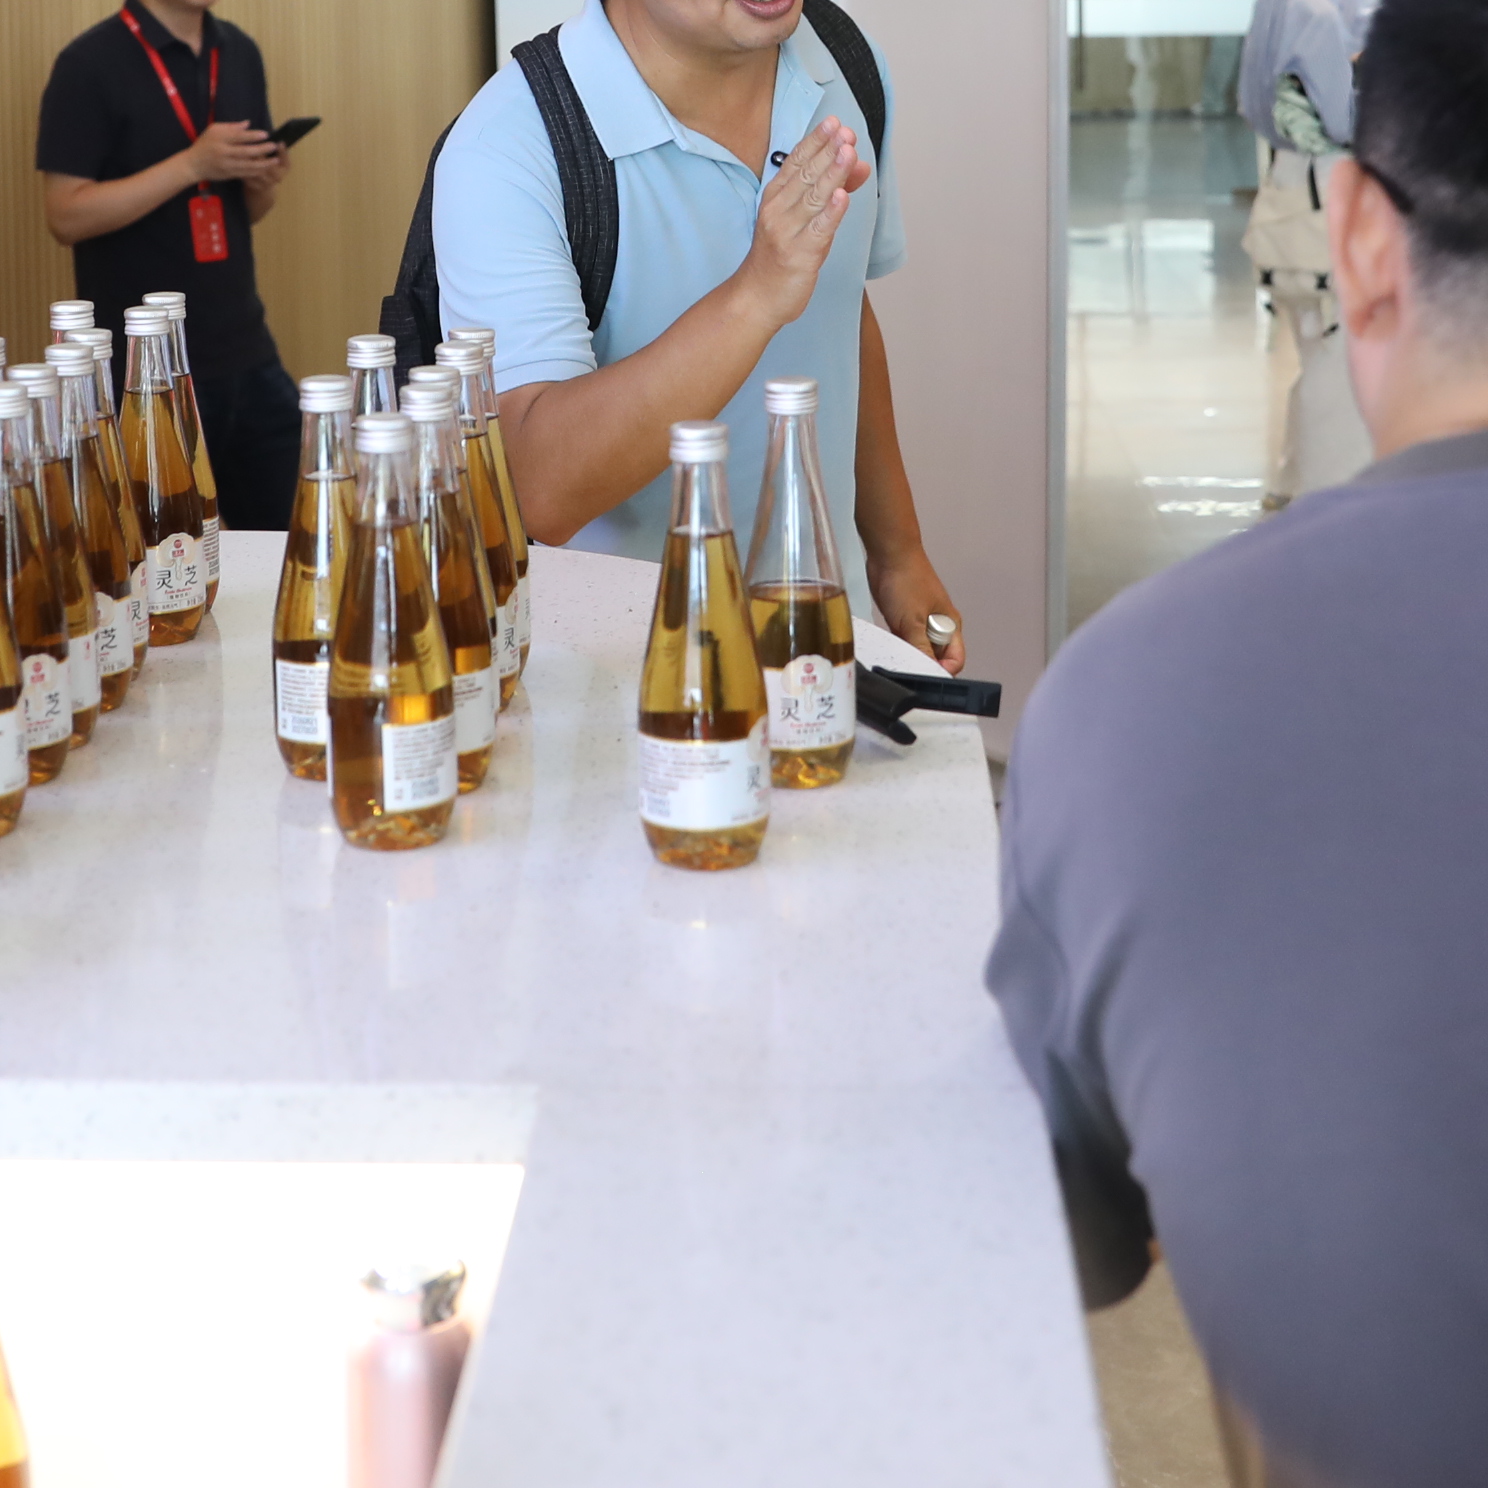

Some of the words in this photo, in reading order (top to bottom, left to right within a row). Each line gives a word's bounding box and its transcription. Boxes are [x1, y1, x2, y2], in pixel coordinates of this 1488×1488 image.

[155, 564, 198, 591] 灵芝
[95, 627, 118, 651] 芝
[780, 695, 836, 722] 灵芝
